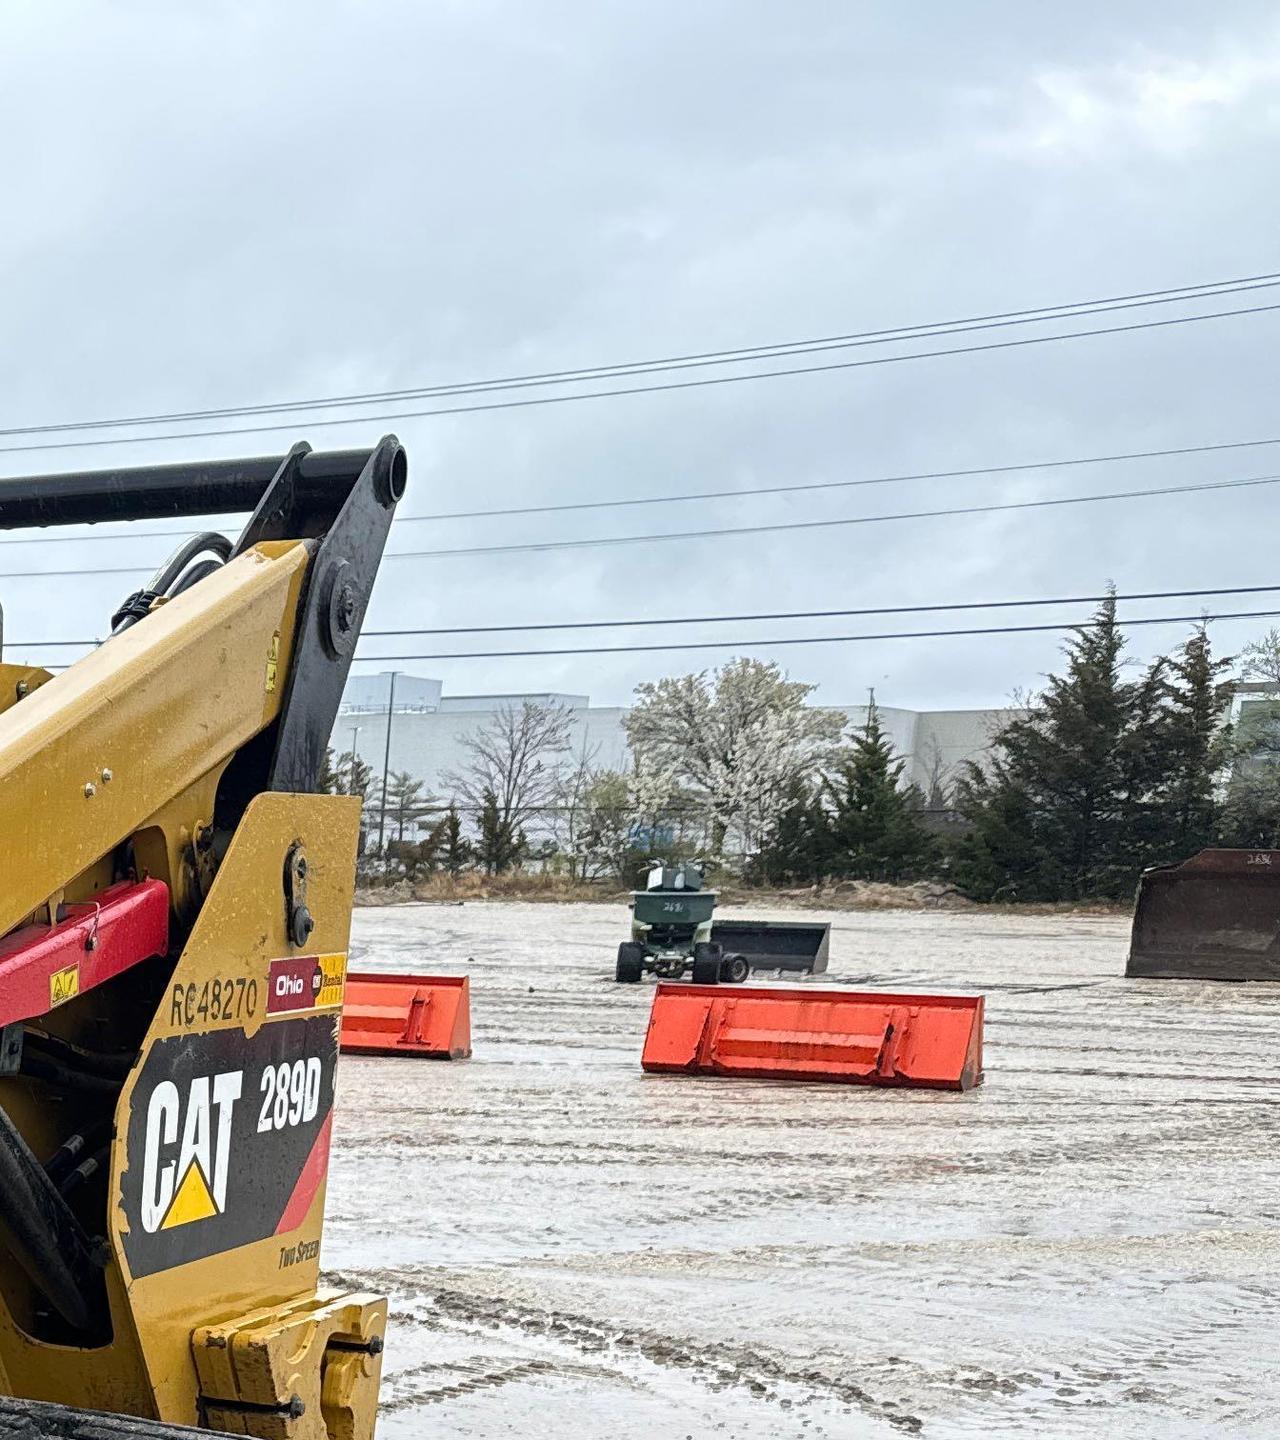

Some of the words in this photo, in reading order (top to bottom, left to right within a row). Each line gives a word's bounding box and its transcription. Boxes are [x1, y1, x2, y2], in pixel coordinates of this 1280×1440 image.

[275, 972, 304, 996] Ohio
[141, 1070, 244, 1233] CAT
[257, 1056, 322, 1133] 289D
